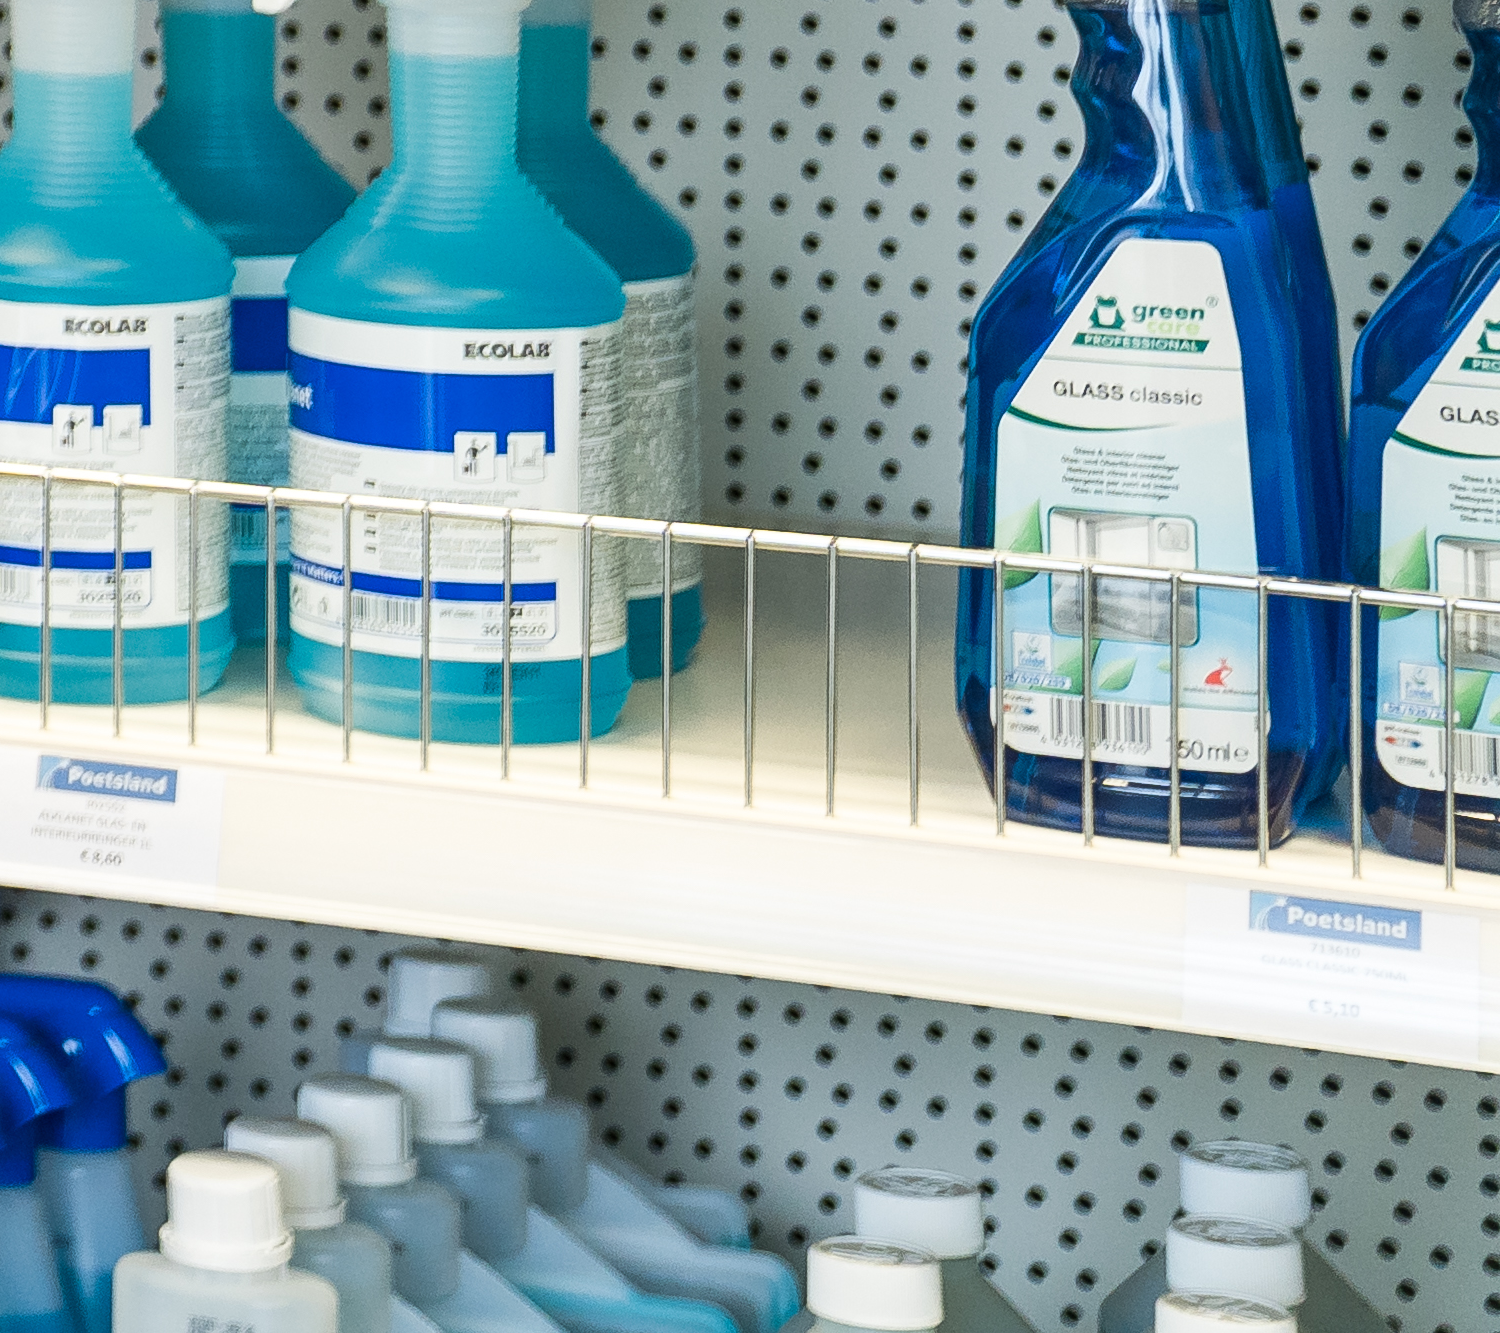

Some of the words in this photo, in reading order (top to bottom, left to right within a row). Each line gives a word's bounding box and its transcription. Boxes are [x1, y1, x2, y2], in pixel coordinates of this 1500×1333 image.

[1131, 304, 1205, 323] green
[64, 318, 148, 334] ECOLAB
[1146, 320, 1200, 336] care
[463, 342, 551, 359] ECOLAB
[1084, 336, 1198, 352] PROFESSIONAL
[1053, 380, 1124, 402] GLASS
[1130, 386, 1203, 406] classic
[1440, 406, 1500, 426] GLAS
[68, 766, 168, 796] Poetsland
[1288, 906, 1407, 940] Poetsland
[1323, 1000, 1360, 1018] 5,10
